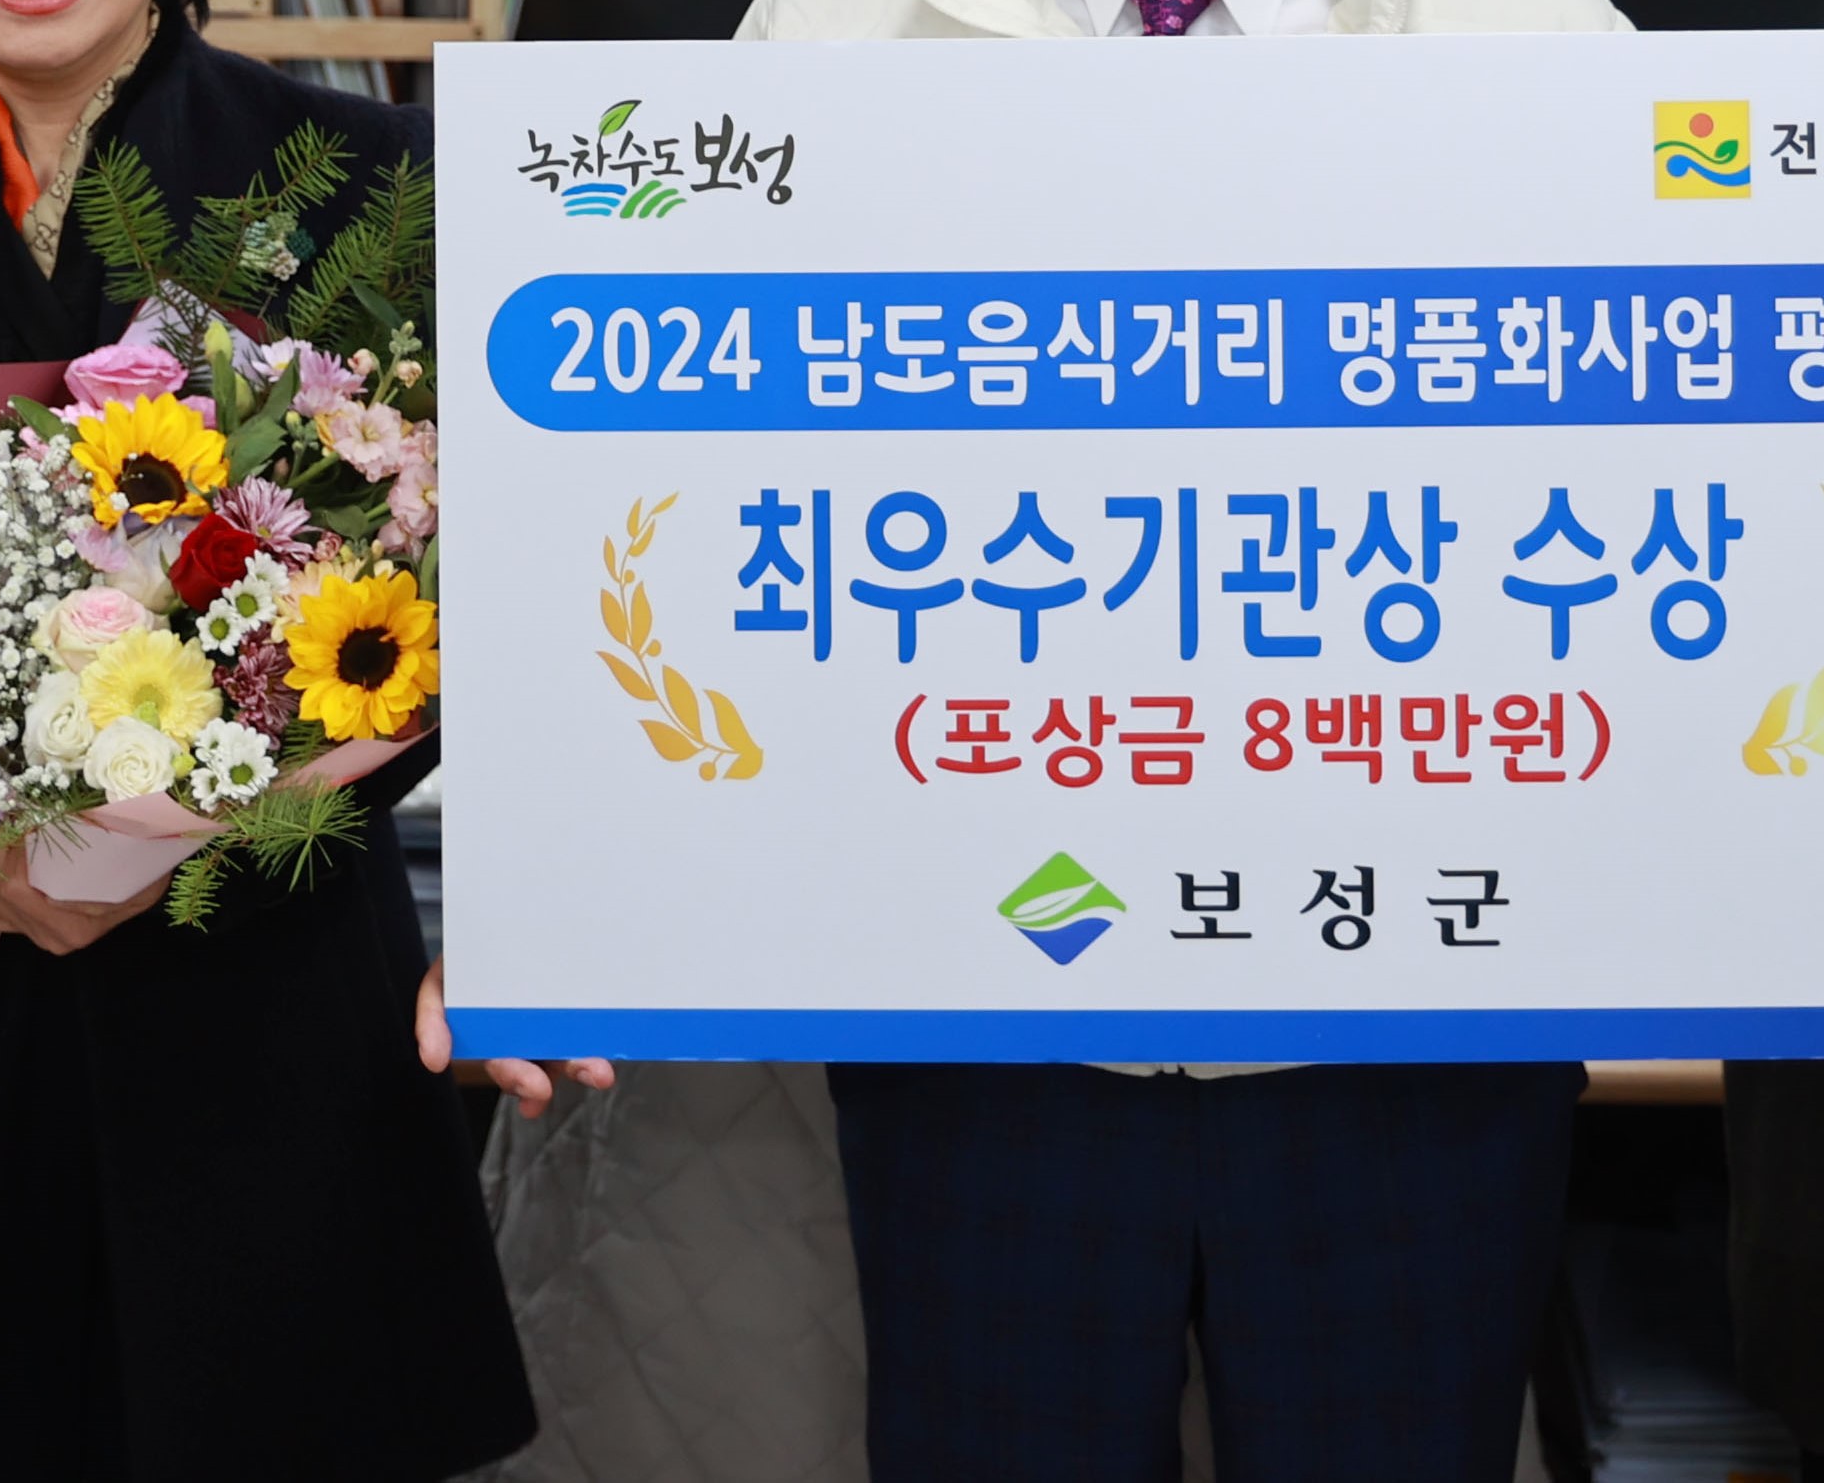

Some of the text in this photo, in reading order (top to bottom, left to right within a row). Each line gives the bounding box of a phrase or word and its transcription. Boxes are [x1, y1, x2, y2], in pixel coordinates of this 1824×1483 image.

[518, 113, 795, 205] 녹차수도 보성
[550, 306, 762, 393] 2024
[796, 299, 1285, 407] 남도음식거리
[1326, 294, 1734, 406] 명품화사업
[735, 482, 1746, 664] 최우수기관상 수상
[895, 691, 1612, 789] (포상금 8백만원)
[1169, 865, 1511, 951] 보성군
